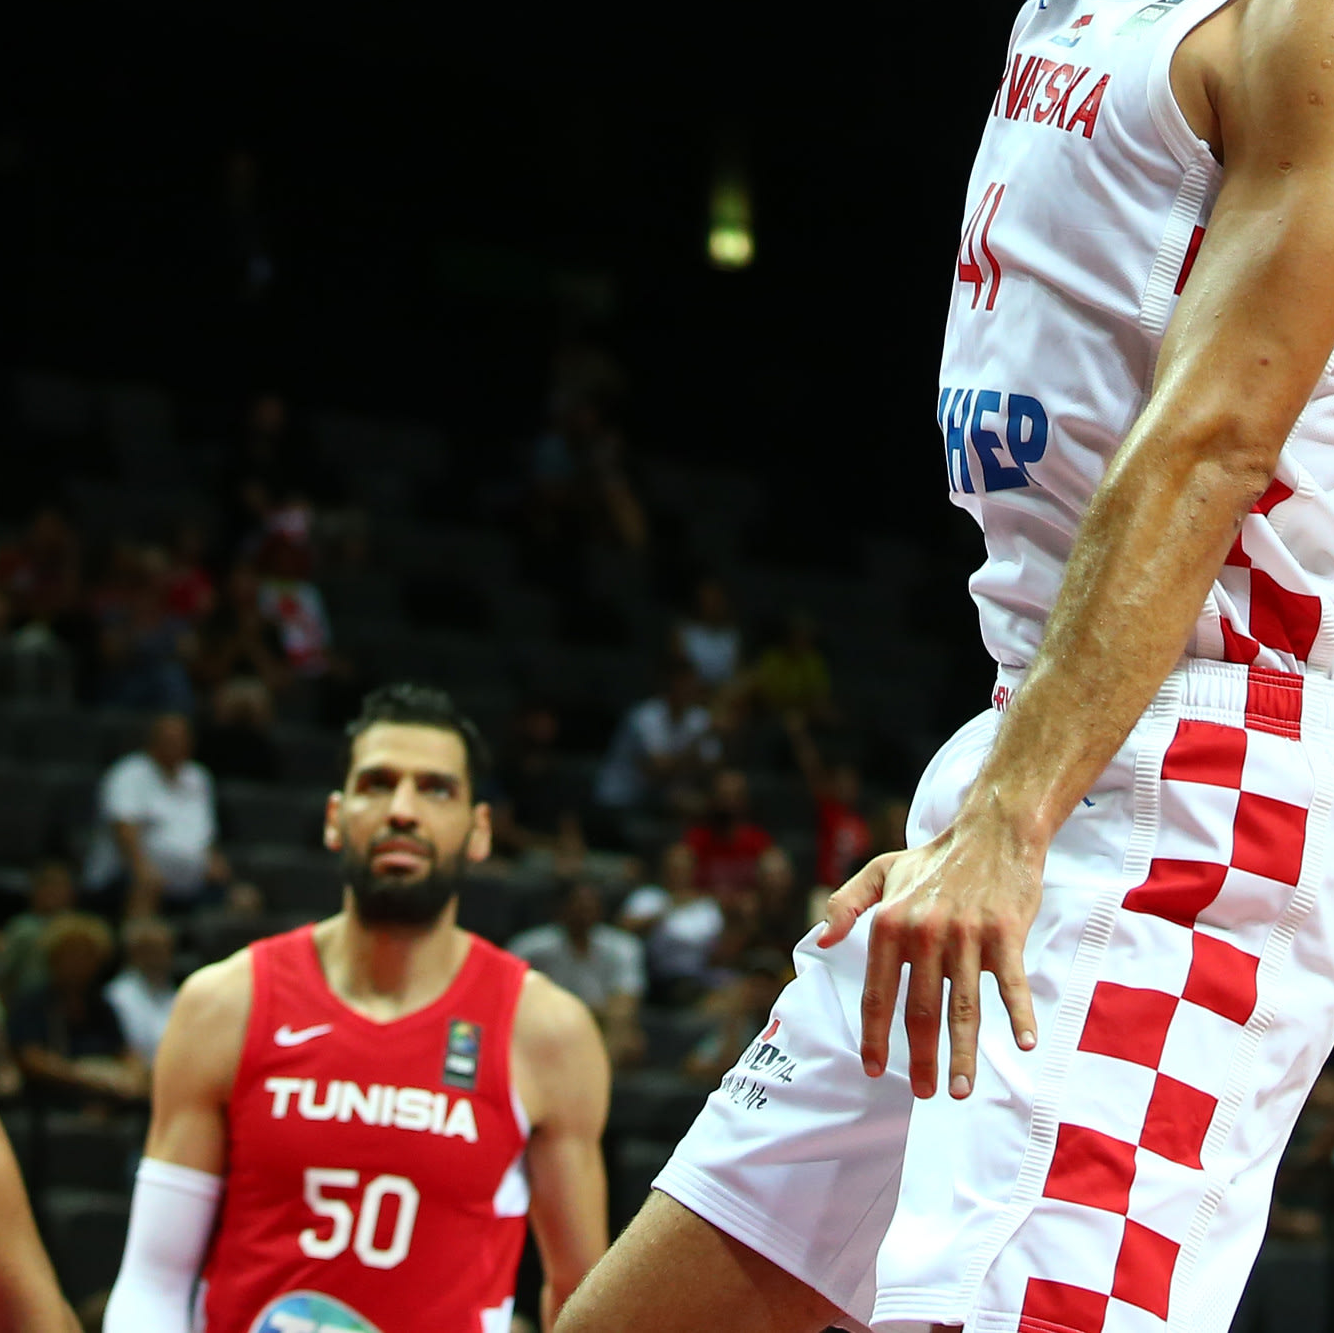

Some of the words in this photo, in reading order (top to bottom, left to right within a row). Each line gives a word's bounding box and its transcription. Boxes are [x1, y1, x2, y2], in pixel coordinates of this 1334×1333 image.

[957, 181, 1006, 312] 41
[947, 388, 1048, 494] HEP
[265, 1077, 479, 1144] TUNISIA
[299, 1167, 420, 1270] 50
